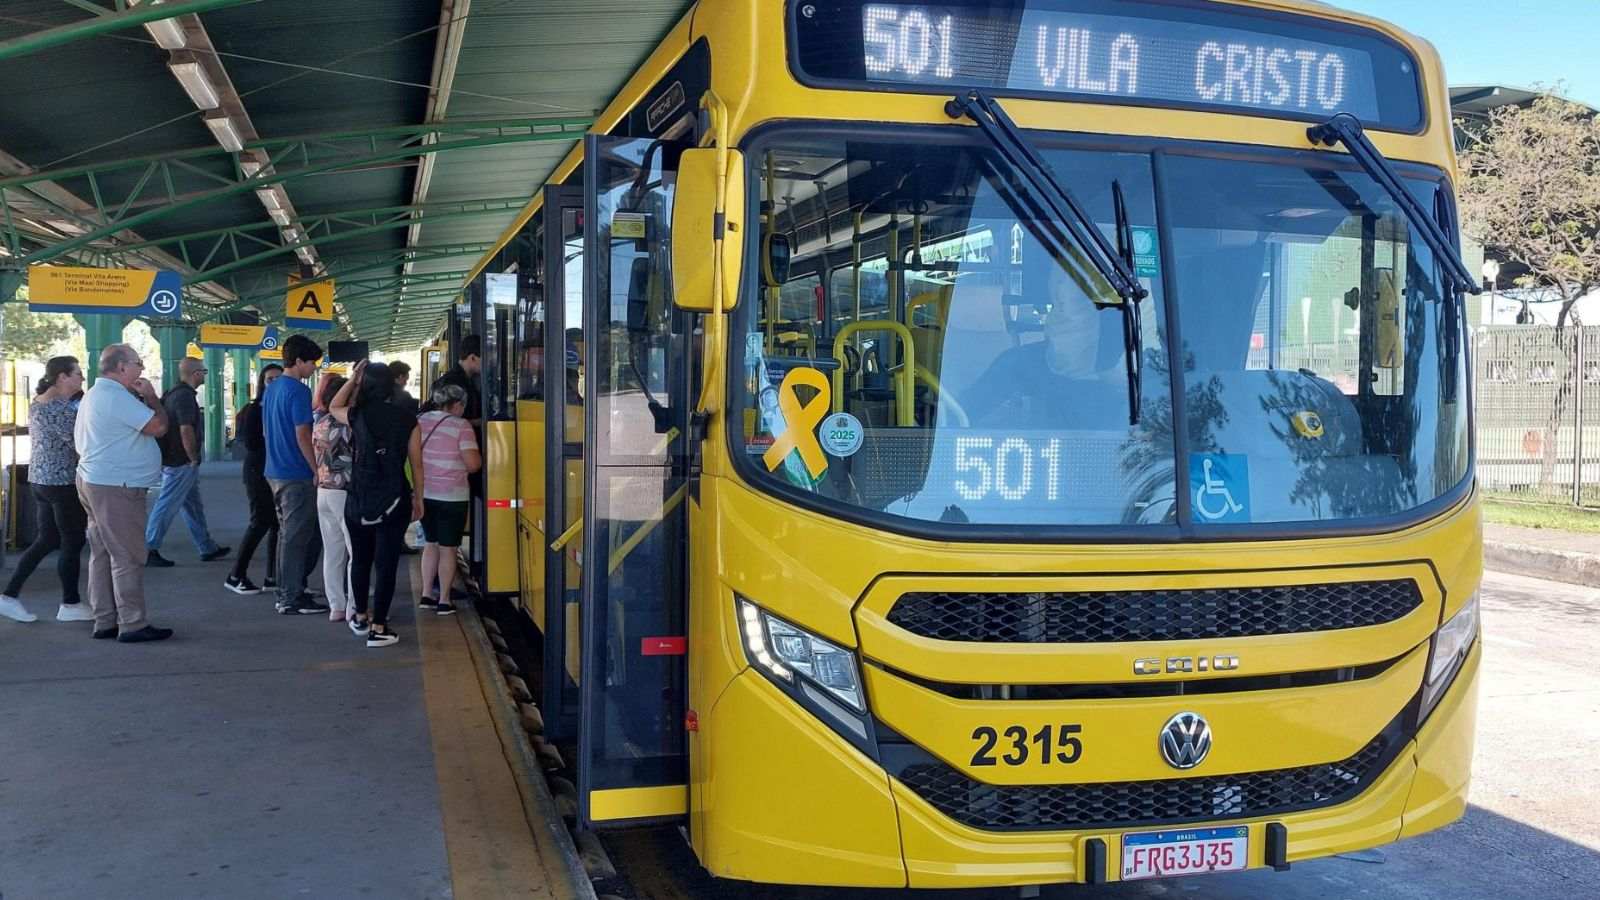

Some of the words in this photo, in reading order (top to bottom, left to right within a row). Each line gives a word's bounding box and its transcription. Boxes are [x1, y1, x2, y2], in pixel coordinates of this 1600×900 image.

[862, 5, 954, 79] 501
[1036, 24, 1139, 94] VILA
[1195, 40, 1346, 110] CRISTO
[64, 272, 92, 280] Terminal
[297, 290, 322, 314] A
[830, 430, 856, 441] 2025
[955, 437, 1060, 501] 501
[1133, 655, 1240, 675] CAIO
[970, 724, 1083, 767] 2315
[1176, 833, 1198, 841] BRASIL
[1133, 842, 1234, 874] FRG3J35
